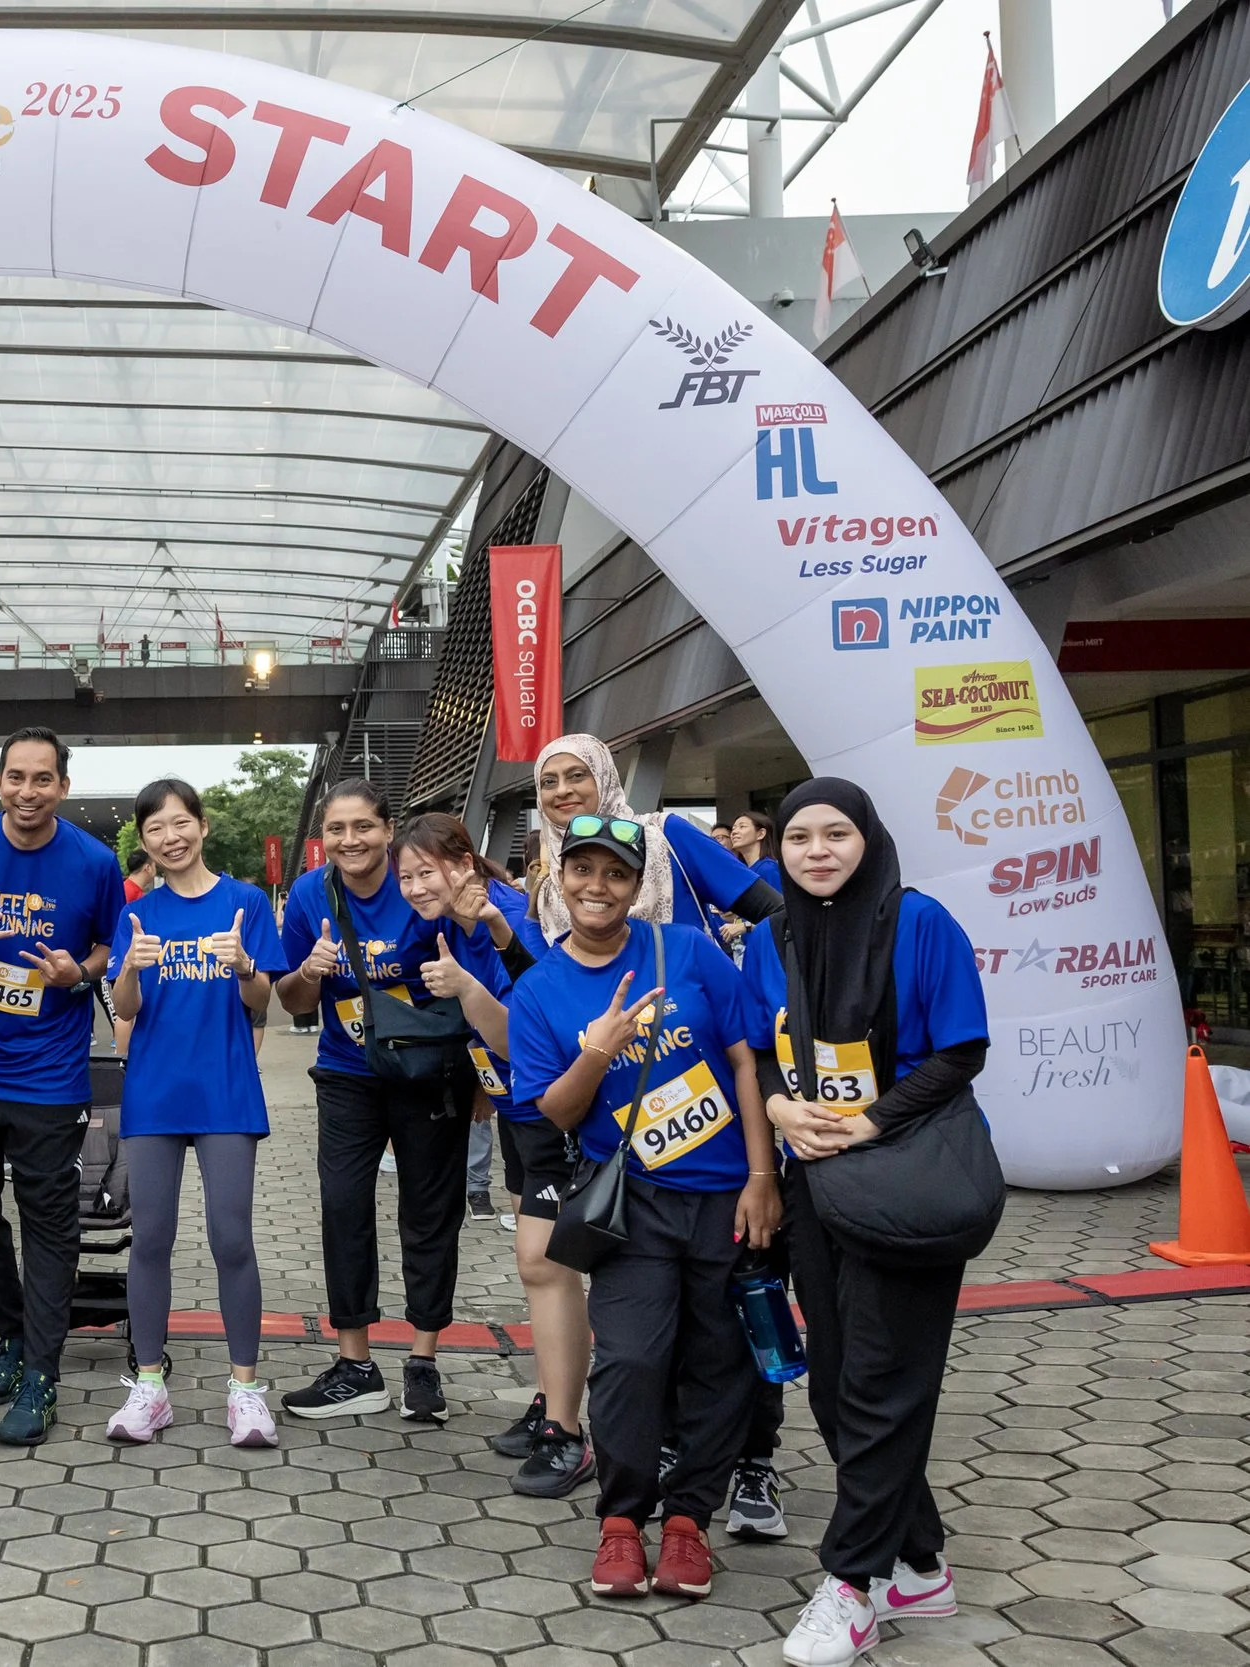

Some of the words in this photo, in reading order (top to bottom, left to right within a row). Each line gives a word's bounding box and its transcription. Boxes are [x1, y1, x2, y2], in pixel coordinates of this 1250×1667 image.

[21, 82, 123, 119] 2025
[144, 86, 641, 339] START
[658, 370, 760, 410] FBT
[756, 427, 838, 500] HL
[777, 514, 938, 547] Vitagen
[799, 558, 852, 578] Less
[860, 554, 927, 577] Sugar
[516, 579, 537, 645] OCBC
[900, 595, 1001, 620] NIPPON
[910, 619, 991, 644] PAINT
[514, 650, 537, 728] square
[995, 769, 1079, 800] climb
[971, 797, 1085, 829] central
[988, 836, 1100, 895] SPIN
[1008, 899, 1049, 917] Low
[1051, 884, 1097, 909] Suds
[158, 954, 231, 984] RUNNING
[1081, 973, 1128, 988] SPORT
[1131, 969, 1157, 983] CARE
[1020, 1019, 1142, 1056] BEAUTY
[788, 1069, 862, 1101] 963
[1022, 1057, 1112, 1096] fresh
[644, 1097, 719, 1155] 9460
